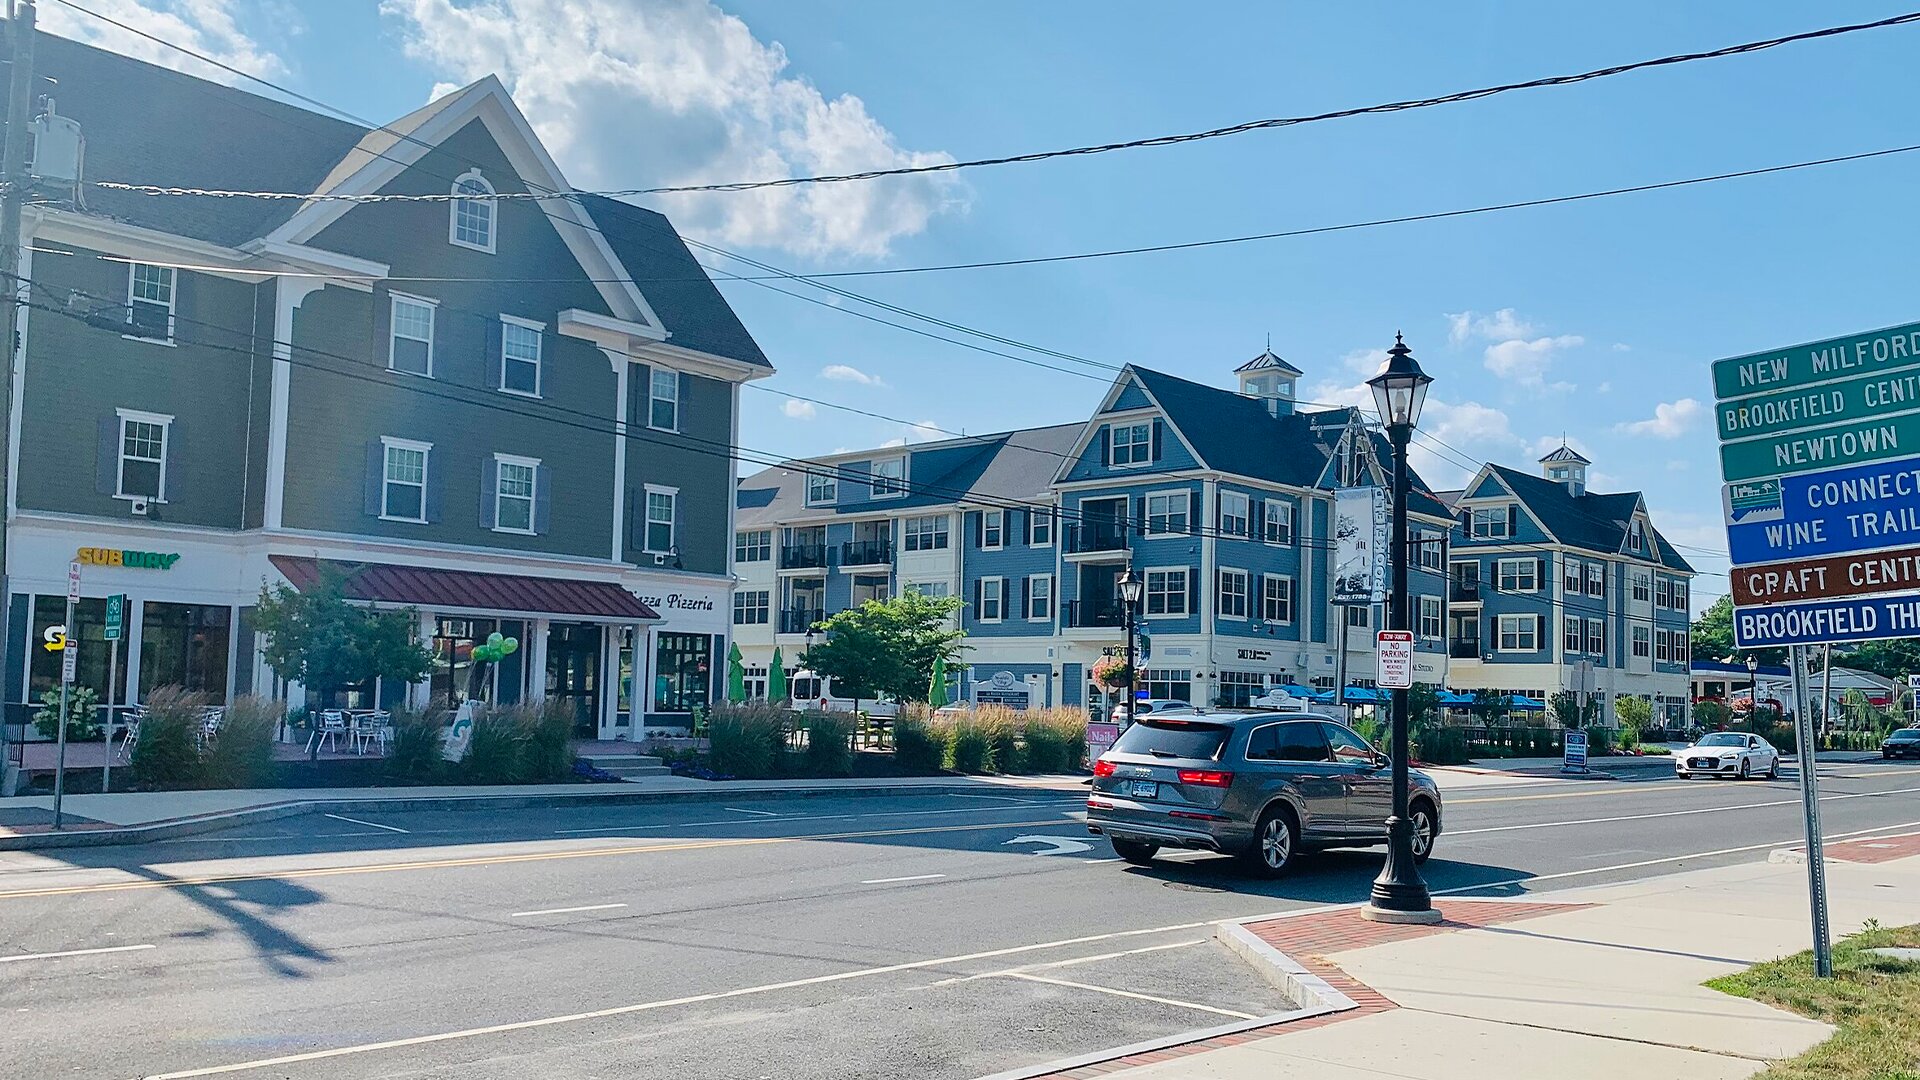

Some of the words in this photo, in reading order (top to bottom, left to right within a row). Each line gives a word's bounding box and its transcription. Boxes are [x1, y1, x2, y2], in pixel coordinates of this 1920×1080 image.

[1739, 357, 1788, 387] NEW
[1726, 390, 1845, 431] BROOKFIELD
[1864, 376, 1920, 407] CENT
[1775, 425, 1898, 467] NEWTOWN
[1765, 519, 1827, 548] WINE
[1846, 507, 1920, 538] TRAIL
[77, 547, 180, 570] SUBWAY
[1749, 566, 1827, 596] CRAFT
[667, 594, 713, 611] Pizzeria
[1741, 604, 1877, 641] BROOKFIELD
[1886, 601, 1920, 630] TH
[1381, 650, 1408, 658] PARKING
[1390, 642, 1400, 650] NO
[1091, 731, 1115, 742] Nails
